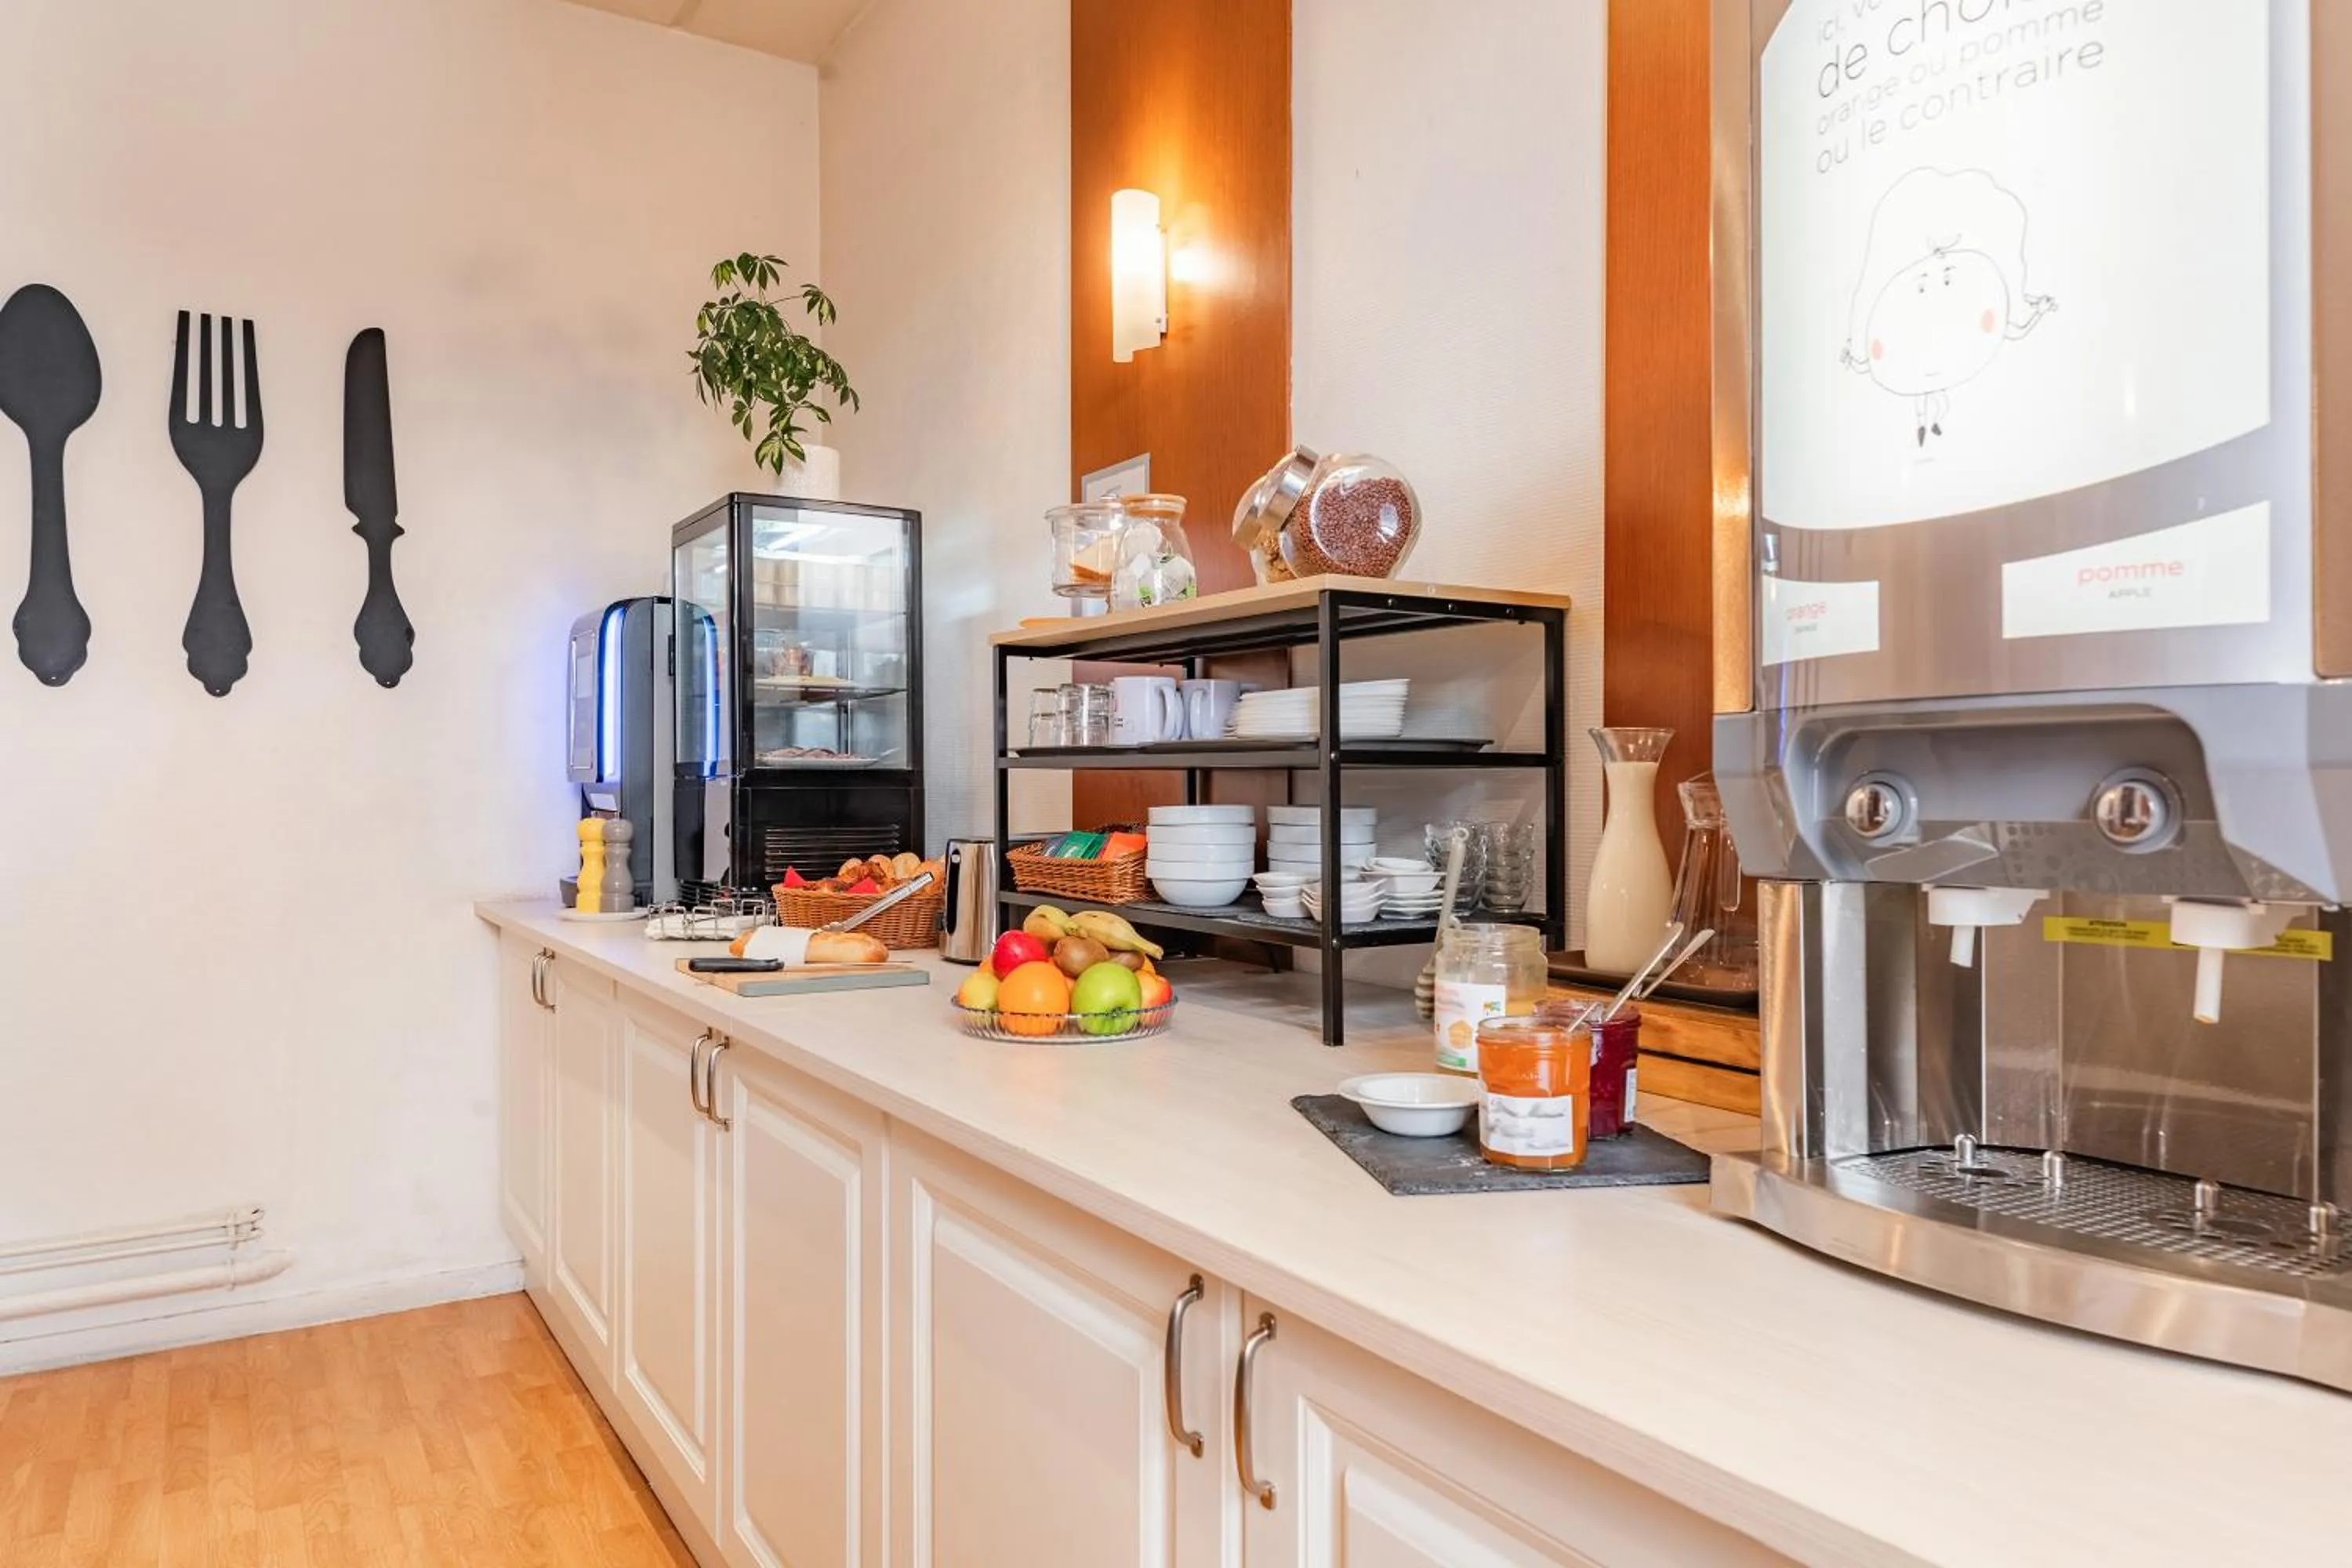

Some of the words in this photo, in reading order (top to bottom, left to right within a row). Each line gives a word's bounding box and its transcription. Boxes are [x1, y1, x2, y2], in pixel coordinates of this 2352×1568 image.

[1816, 76, 1900, 136] orange
[1908, 49, 1947, 85] ou
[1958, 0, 2103, 69] pomme
[1817, 43, 1868, 98] de
[1888, 0, 2034, 56] cho
[1816, 137, 1849, 175] ou
[1860, 118, 1887, 152] le
[1900, 40, 2104, 131] contraire
[2077, 560, 2183, 586] pomme
